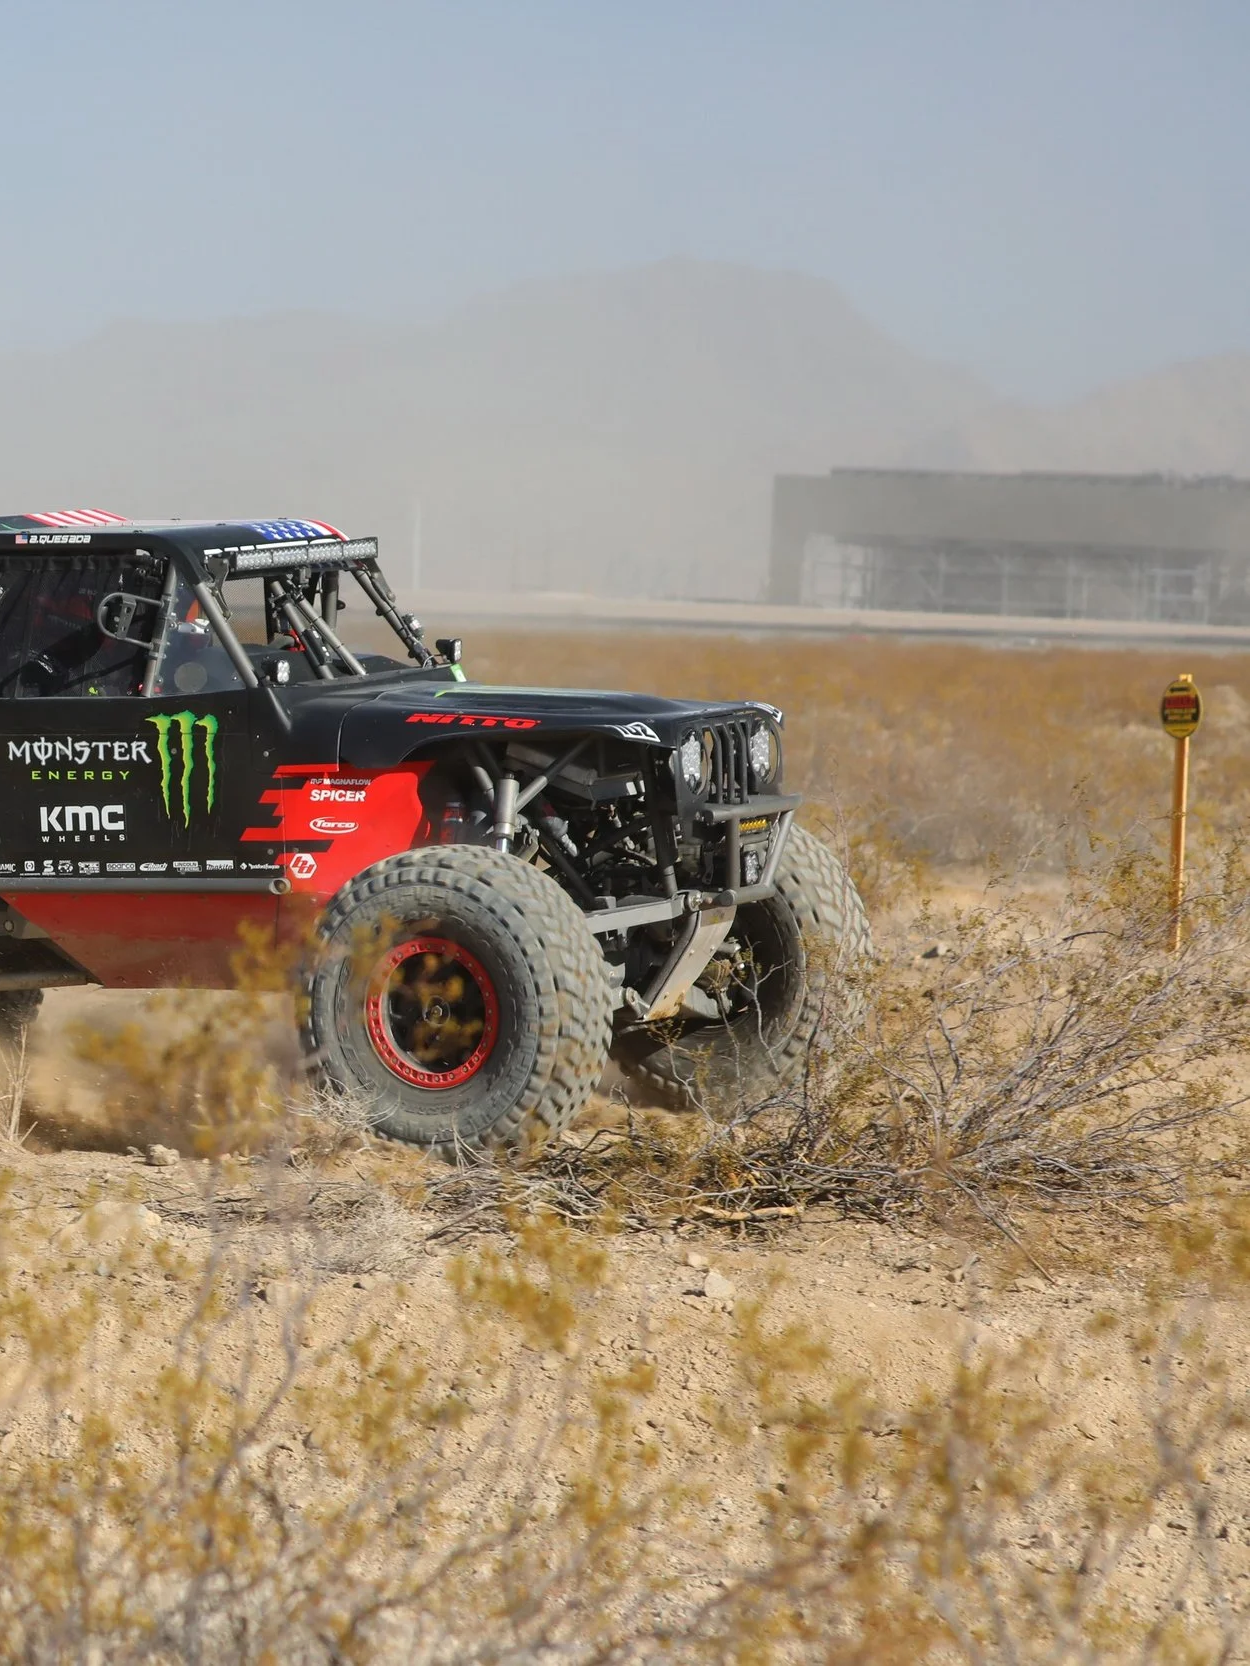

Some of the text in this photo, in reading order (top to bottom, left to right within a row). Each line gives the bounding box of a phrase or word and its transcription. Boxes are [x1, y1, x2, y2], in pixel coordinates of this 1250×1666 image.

[405, 713, 541, 729] NITTO
[7, 736, 152, 766] MONSTER
[31, 770, 130, 780] ENERGY
[310, 789, 367, 802] SPICER
[39, 804, 125, 832] KMC
[315, 819, 356, 828] Torco
[41, 833, 126, 843] WHEELS
